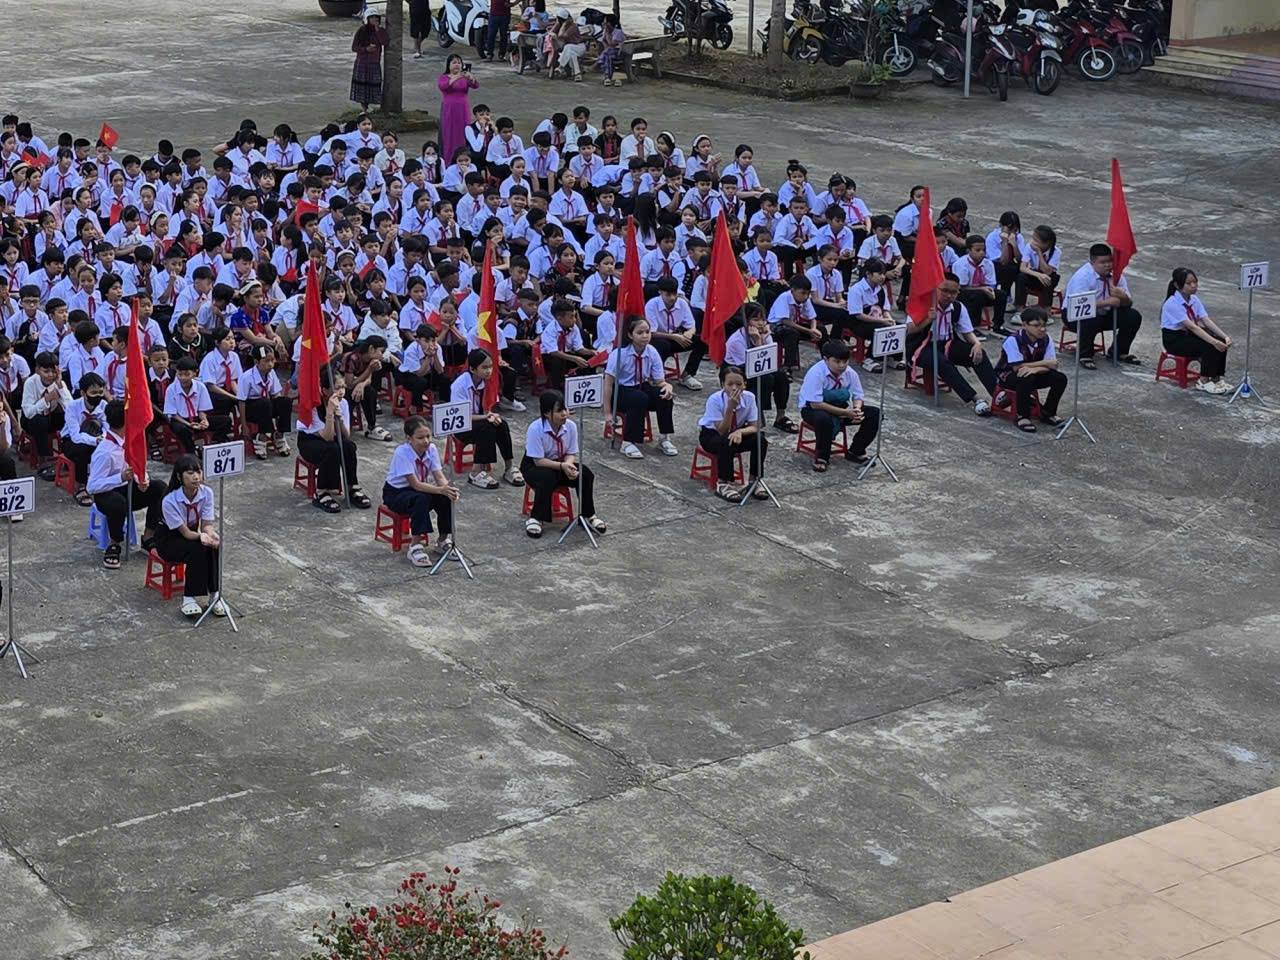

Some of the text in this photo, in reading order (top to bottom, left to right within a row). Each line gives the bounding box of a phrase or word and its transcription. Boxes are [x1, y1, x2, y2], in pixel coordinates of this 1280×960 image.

[1248, 274, 1263, 286] 7/1
[1074, 304, 1091, 317] 7/2
[881, 338, 899, 352] 7/3
[755, 358, 771, 372] 6/1
[573, 389, 596, 403] 6/2
[442, 416, 464, 430] 6/3
[214, 457, 235, 472] 8/1
[4, 486, 20, 495] LỚP
